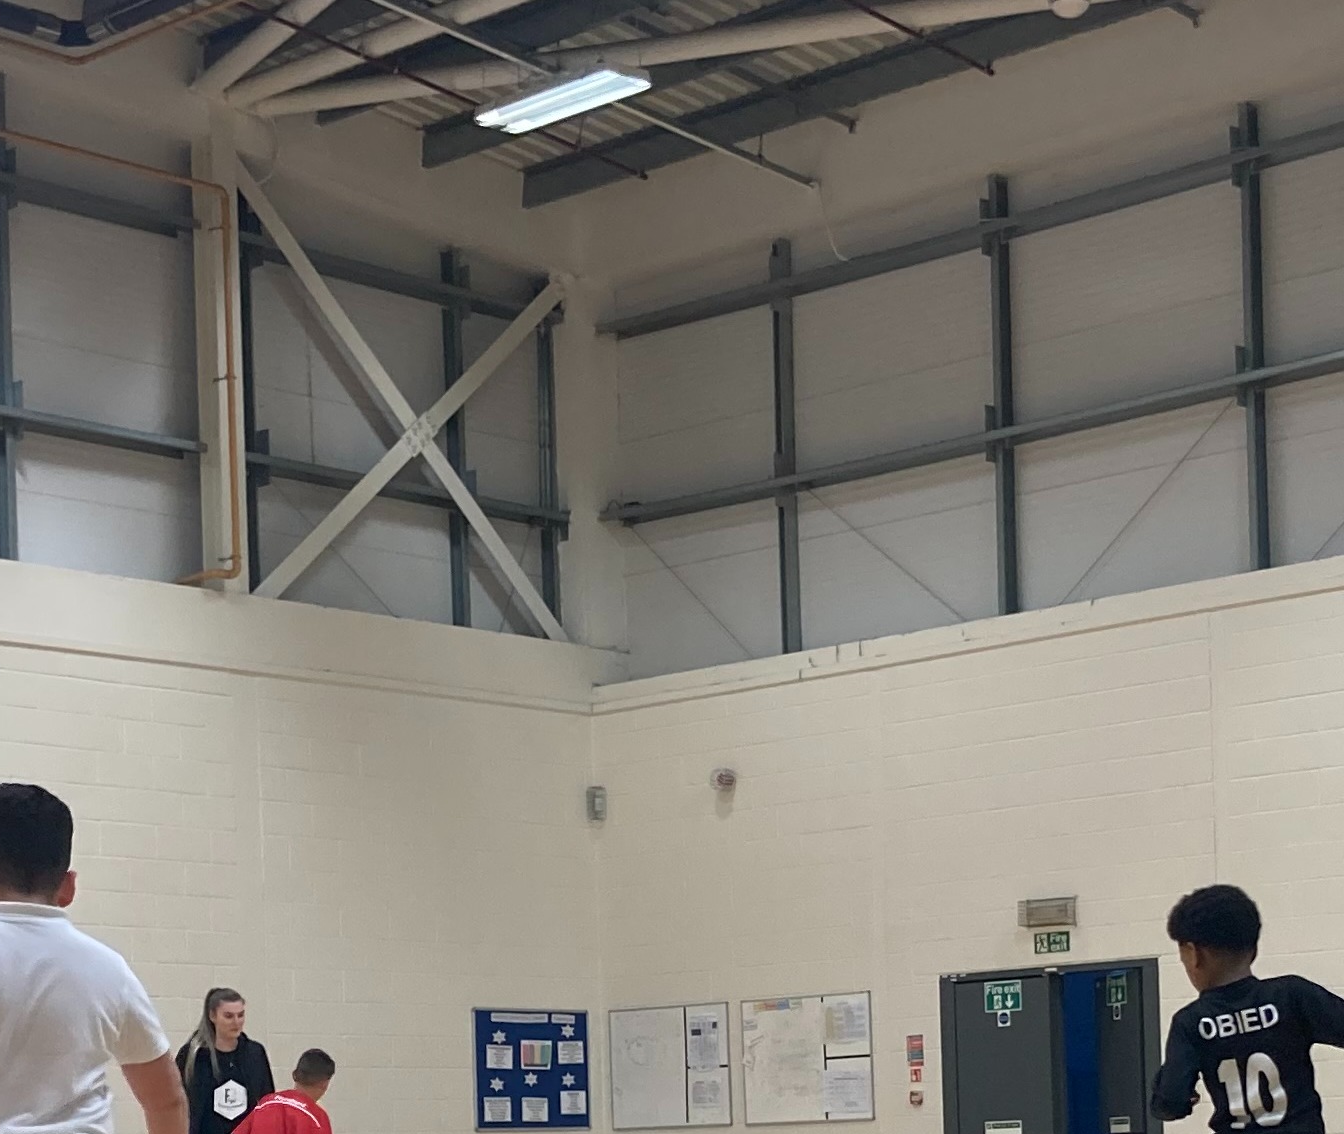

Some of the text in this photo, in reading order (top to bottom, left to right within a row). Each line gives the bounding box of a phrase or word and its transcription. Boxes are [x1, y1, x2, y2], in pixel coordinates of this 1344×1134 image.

[986, 983, 1021, 995] Fire exit
[1199, 1003, 1279, 1040] OBIED
[1217, 1052, 1287, 1129] 10
